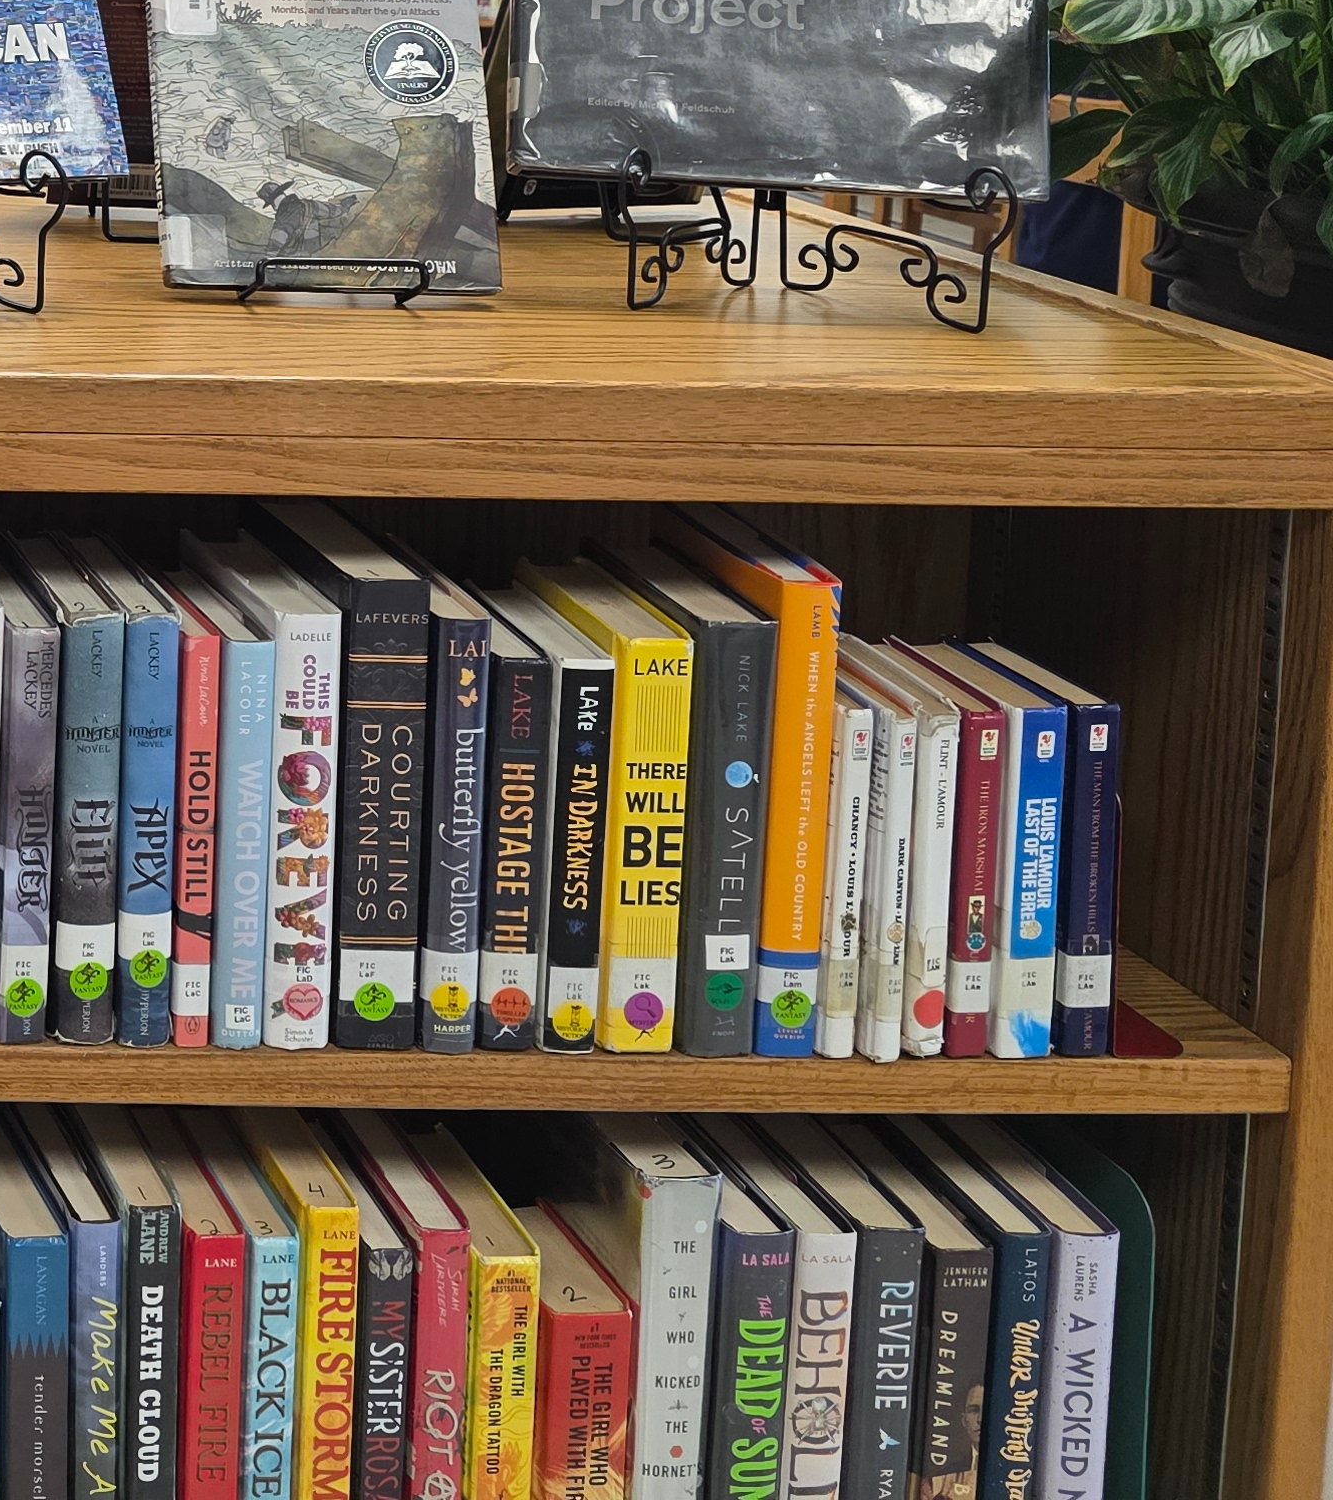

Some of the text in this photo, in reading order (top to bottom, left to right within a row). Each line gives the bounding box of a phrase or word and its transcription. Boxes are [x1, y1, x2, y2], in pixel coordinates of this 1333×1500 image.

[271, 6, 440, 18] Months, and Years after the 9/11 Attacks
[587, 97, 636, 111] Edited by
[681, 102, 735, 115] Feldschuh
[53, 117, 73, 132] 11
[812, 605, 822, 639] LAMB
[290, 632, 332, 642] LADELLE
[634, 658, 688, 676] LAKE
[627, 763, 686, 780] THERE
[626, 793, 684, 813] WILL
[184, 751, 211, 902] HOLD STILL
[356, 724, 383, 923] DARKNESS
[387, 725, 413, 923] COURTING
[622, 826, 682, 869] BE
[620, 881, 680, 906] LIES
[204, 1258, 237, 1268] LANE
[669, 1286, 698, 1299] GIRL
[666, 1331, 695, 1344] WHO
[876, 1282, 913, 1410] REVERIE
[138, 1285, 164, 1483] DEATH CLOUD
[655, 1374, 701, 1389] KICKED
[931, 1311, 959, 1467] DREAMLAND
